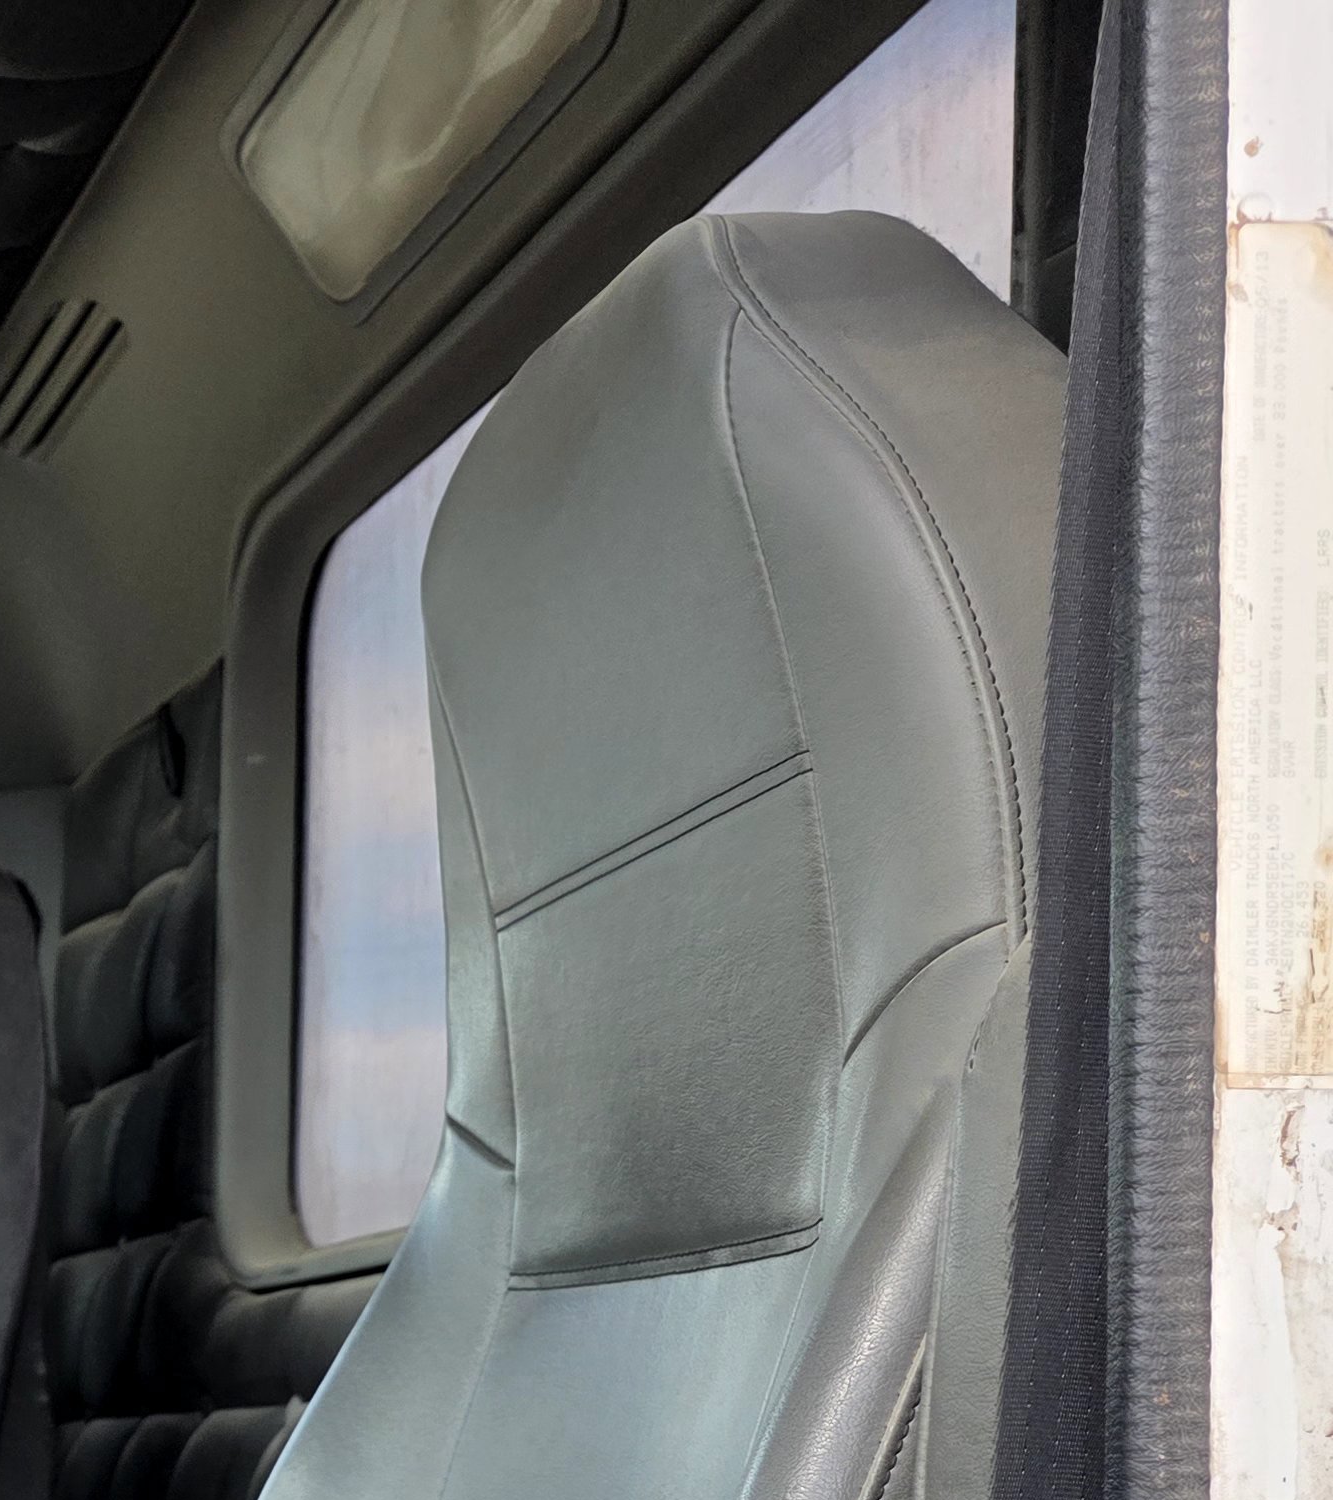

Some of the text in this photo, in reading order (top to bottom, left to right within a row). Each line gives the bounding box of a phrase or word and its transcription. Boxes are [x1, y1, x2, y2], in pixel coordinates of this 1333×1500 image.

[1248, 659, 1263, 689] LLC
[1247, 697, 1263, 766] AMERICA
[1246, 774, 1262, 823] NORTH
[1245, 831, 1261, 890] TRUCKS
[1245, 899, 1260, 968] DAIMLER
